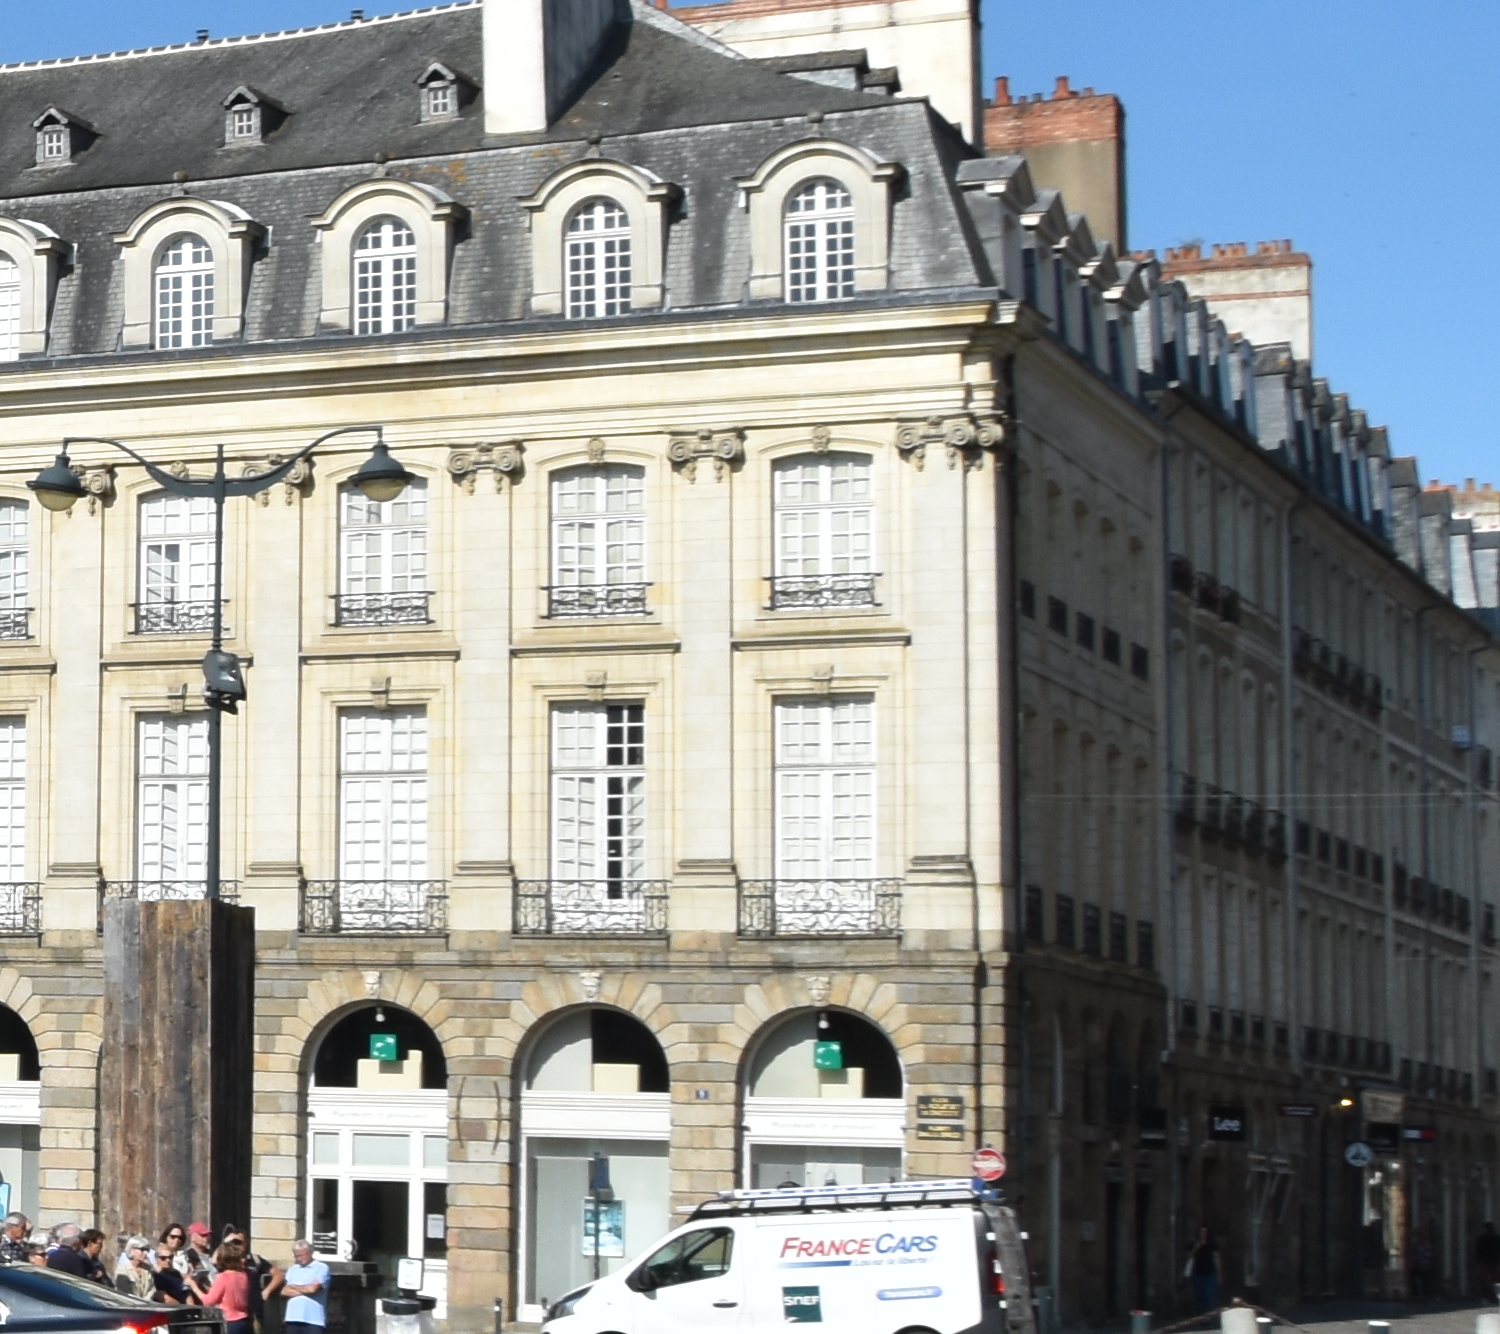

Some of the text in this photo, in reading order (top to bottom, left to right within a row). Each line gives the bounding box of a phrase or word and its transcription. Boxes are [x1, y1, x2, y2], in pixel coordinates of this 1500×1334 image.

[1213, 1117, 1242, 1132] Lee
[779, 1233, 939, 1259] FRANCE CARS
